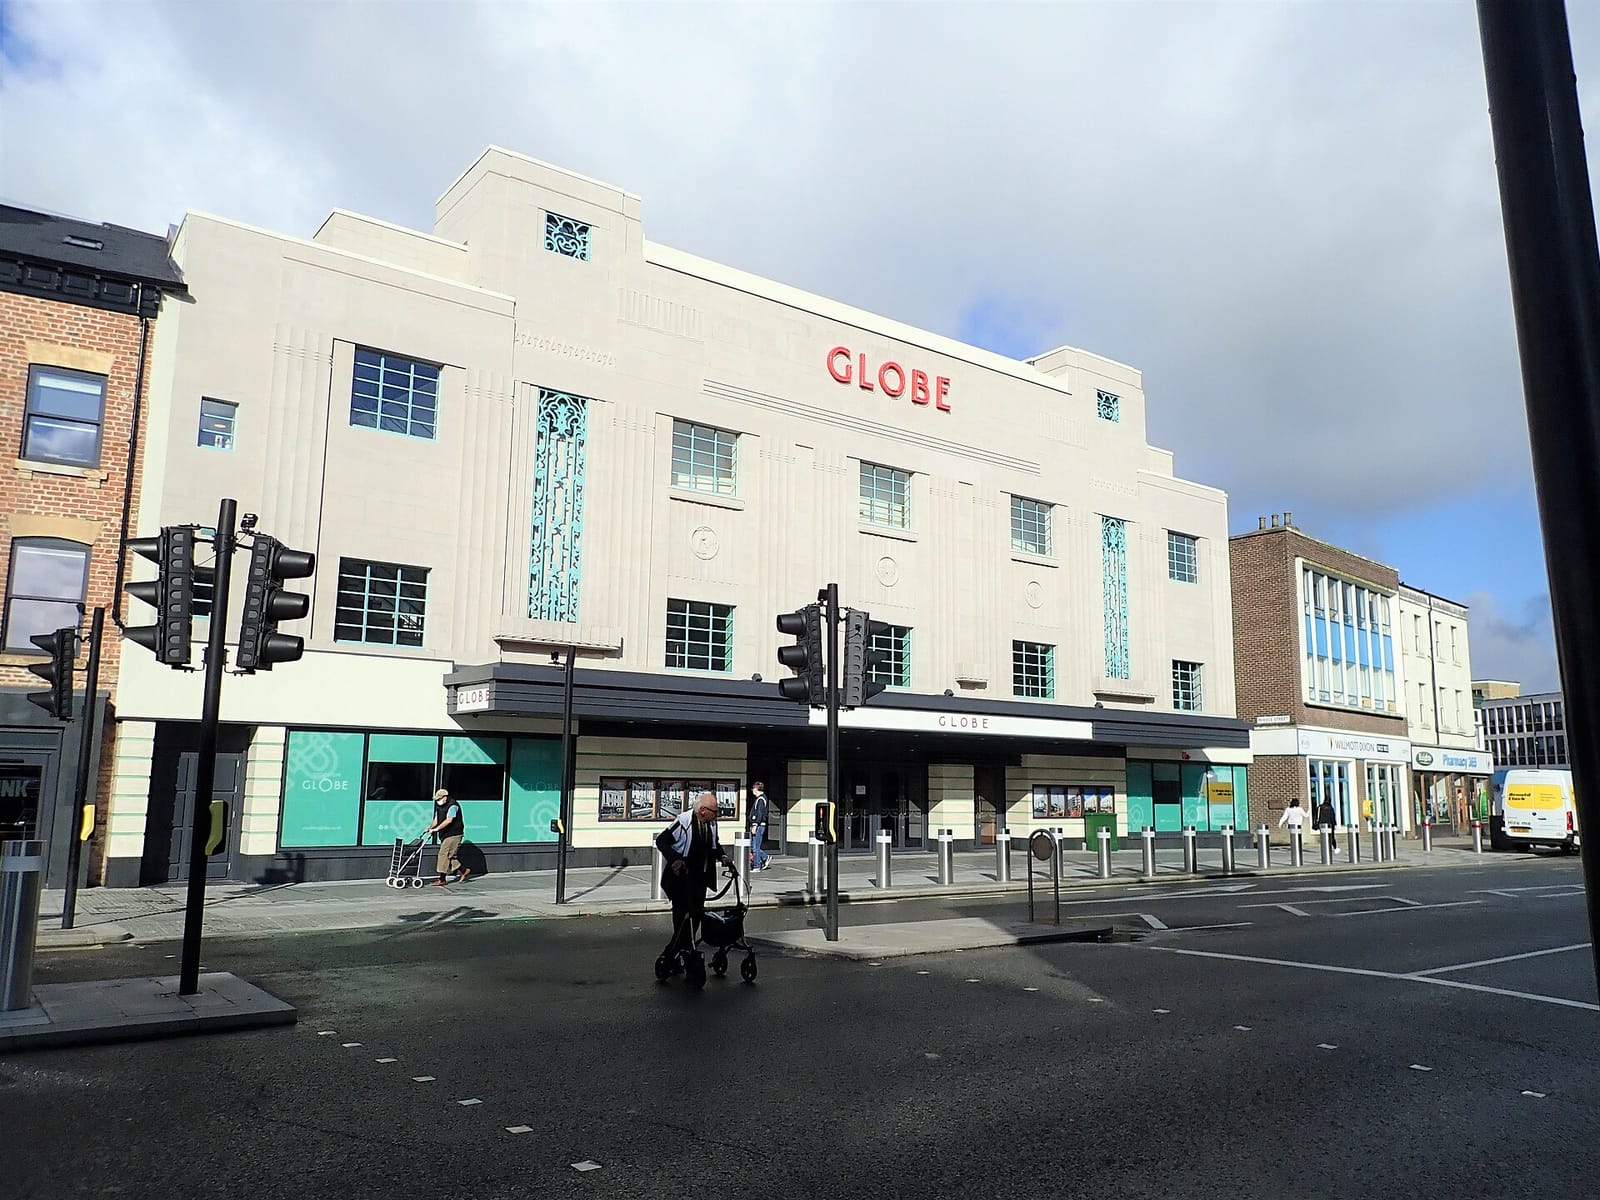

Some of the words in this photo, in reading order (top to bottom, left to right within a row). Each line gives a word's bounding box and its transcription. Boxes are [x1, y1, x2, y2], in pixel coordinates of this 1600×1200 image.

[826, 346, 952, 413] GLOBE
[458, 690, 491, 705] GLOBE
[938, 715, 989, 729] GLOBE
[1359, 741, 1375, 752] DIXON
[1442, 753, 1468, 770] Pharmacy
[0, 779, 29, 798] NK
[302, 778, 349, 792] GLOBE
